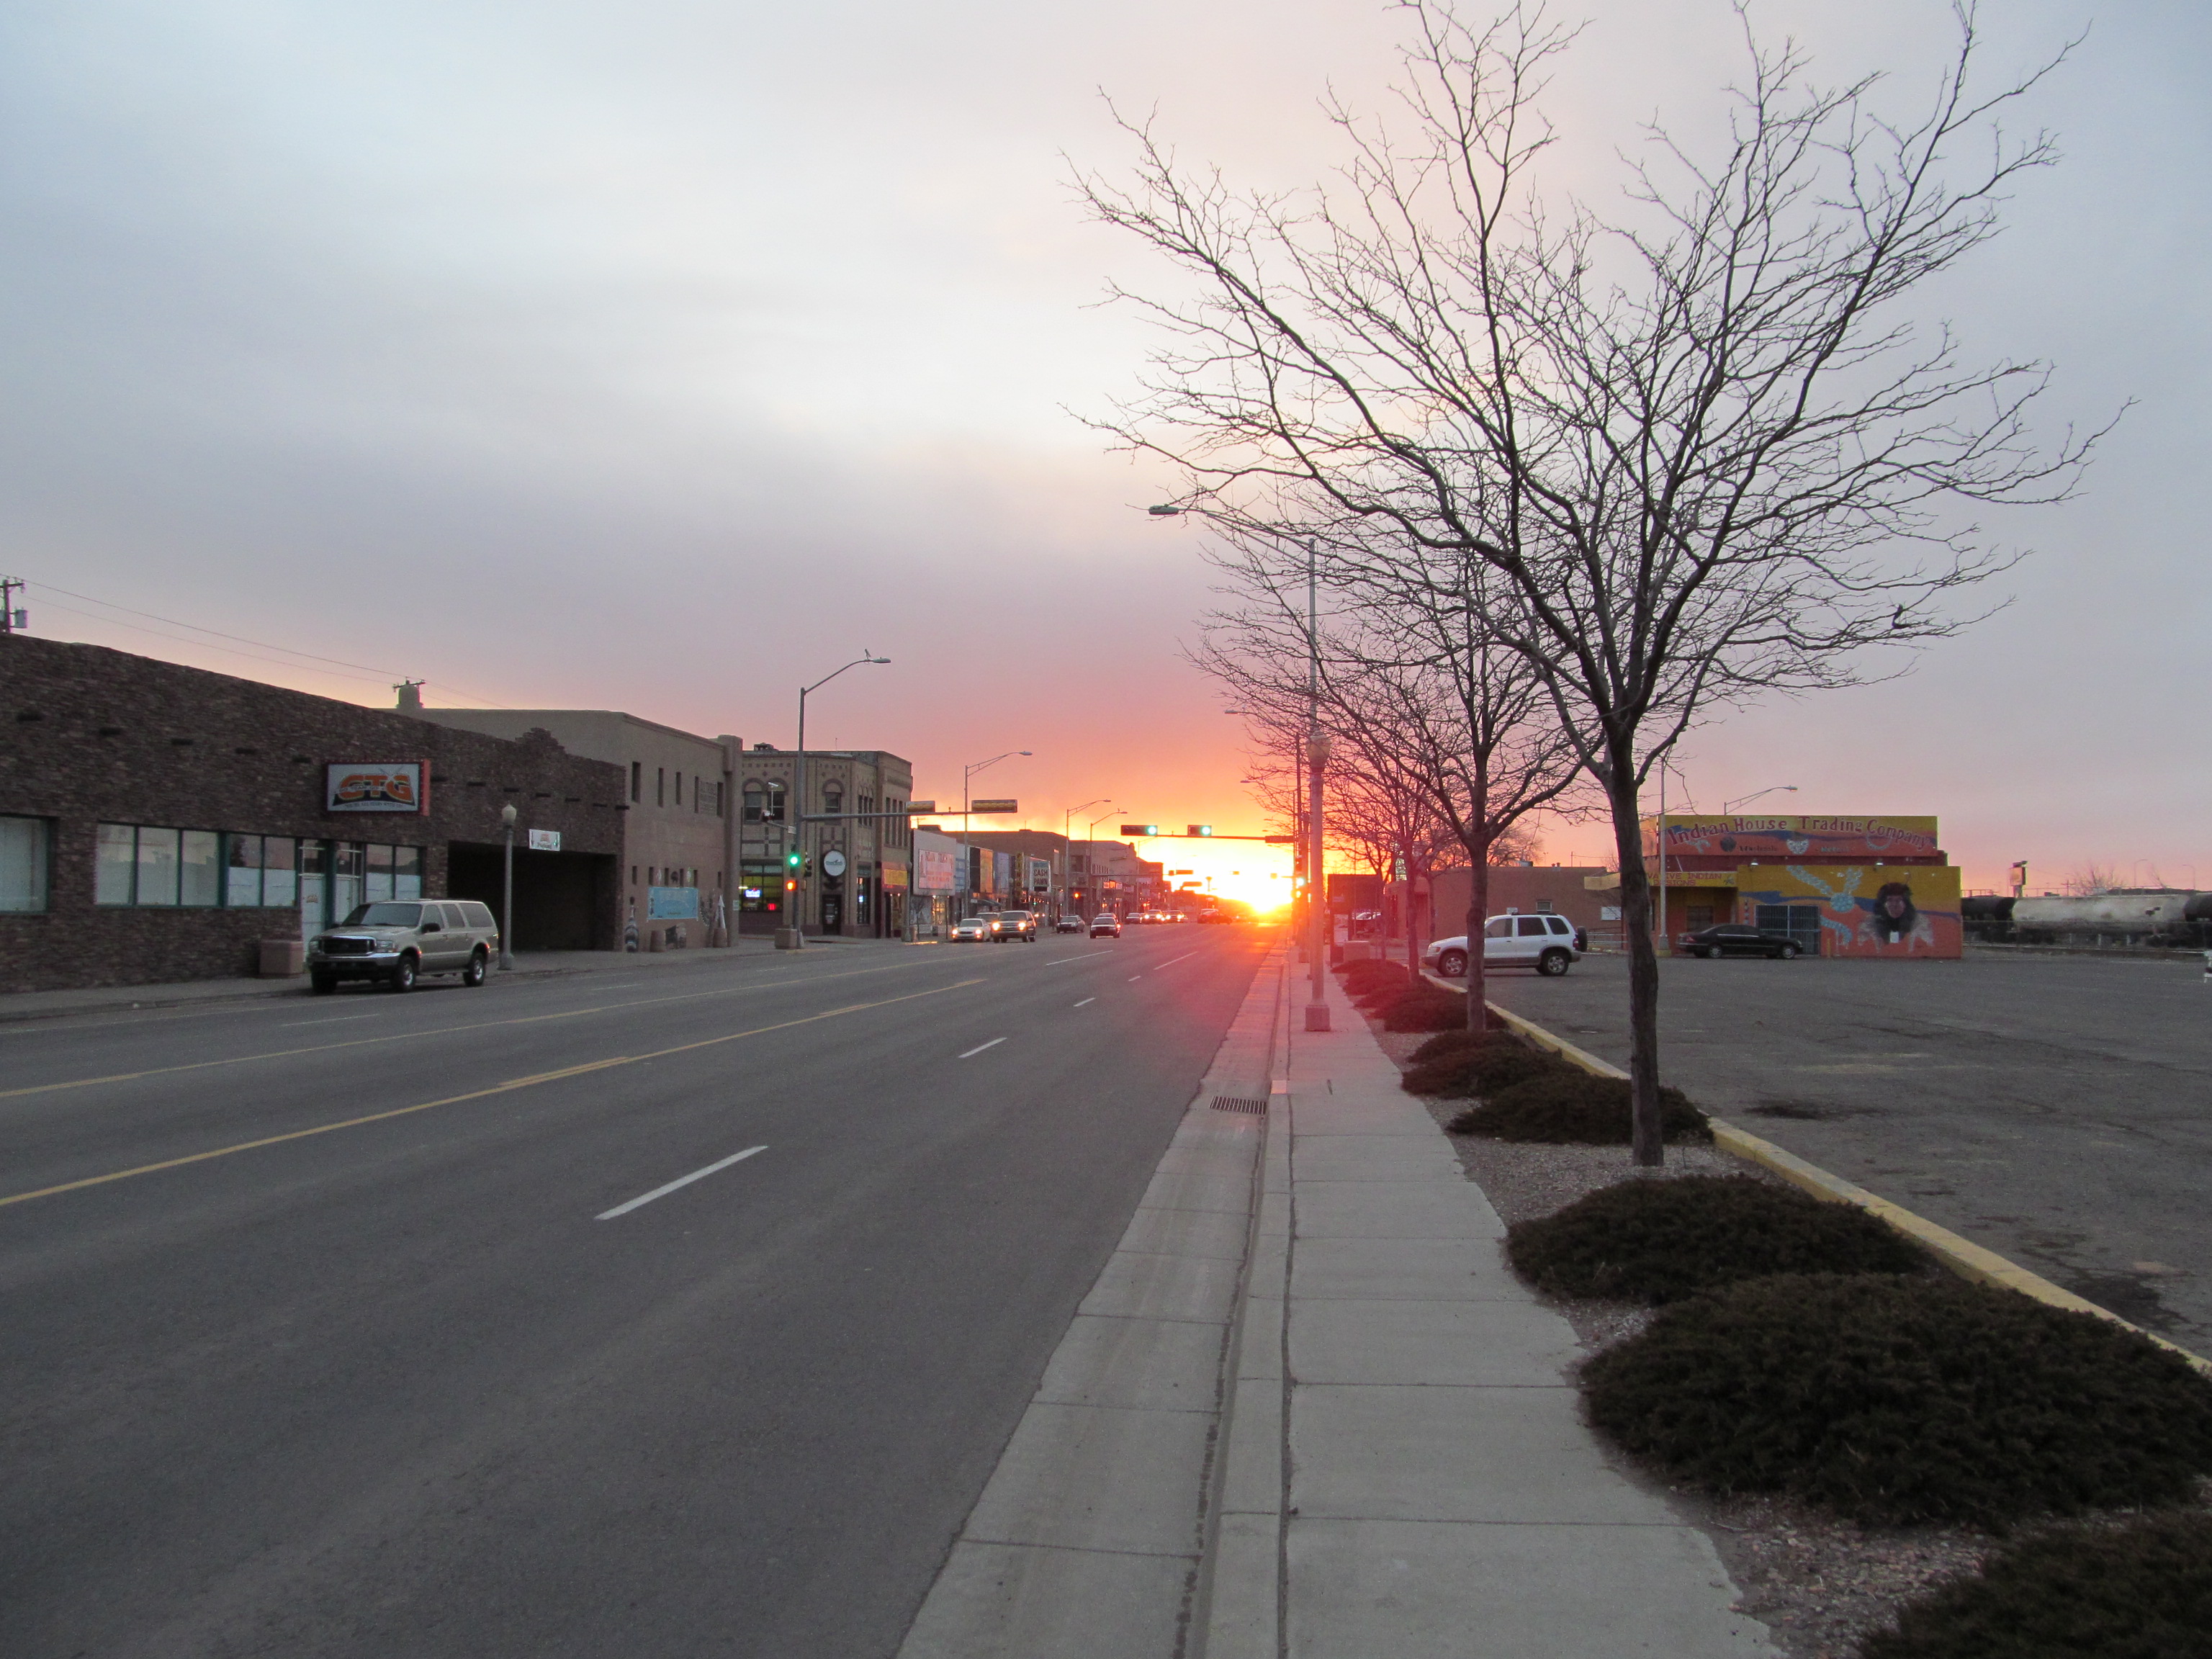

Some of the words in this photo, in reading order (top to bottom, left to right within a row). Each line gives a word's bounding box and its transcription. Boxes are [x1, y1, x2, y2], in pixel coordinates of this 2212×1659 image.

[1668, 822, 1729, 845] Indian
[1734, 817, 1787, 832] House
[1798, 815, 1863, 833] Trading
[1866, 819, 1925, 851] Company
[1033, 869, 1048, 878] CASH
